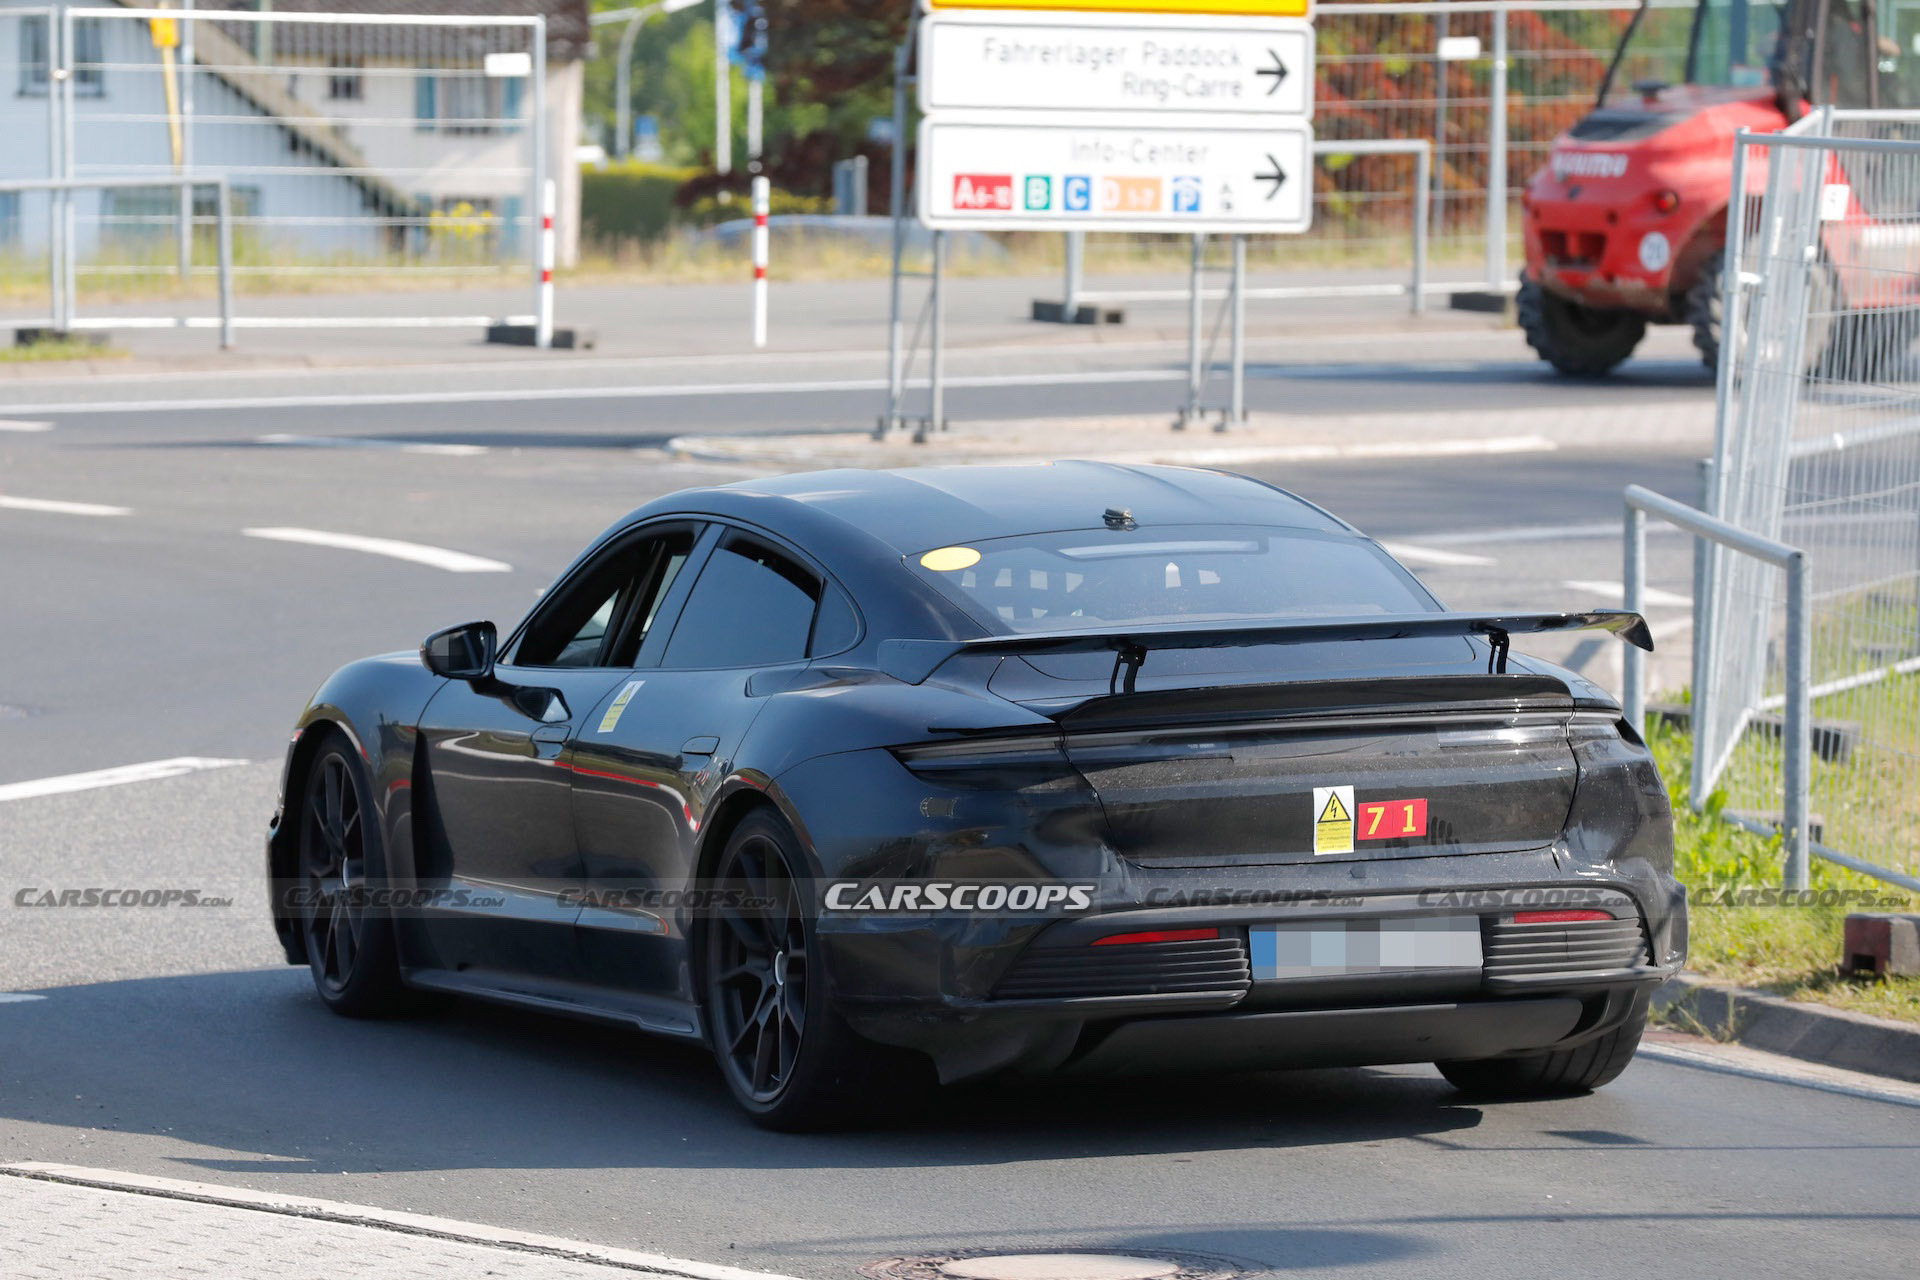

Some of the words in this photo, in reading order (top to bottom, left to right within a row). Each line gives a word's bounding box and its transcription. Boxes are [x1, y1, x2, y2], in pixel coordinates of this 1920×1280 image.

[983, 37, 1127, 71] Fahrerlager
[1142, 40, 1242, 67] Paddock
[1069, 136, 1210, 163] Info-Center
[1027, 177, 1049, 208] B
[1067, 178, 1087, 208] C
